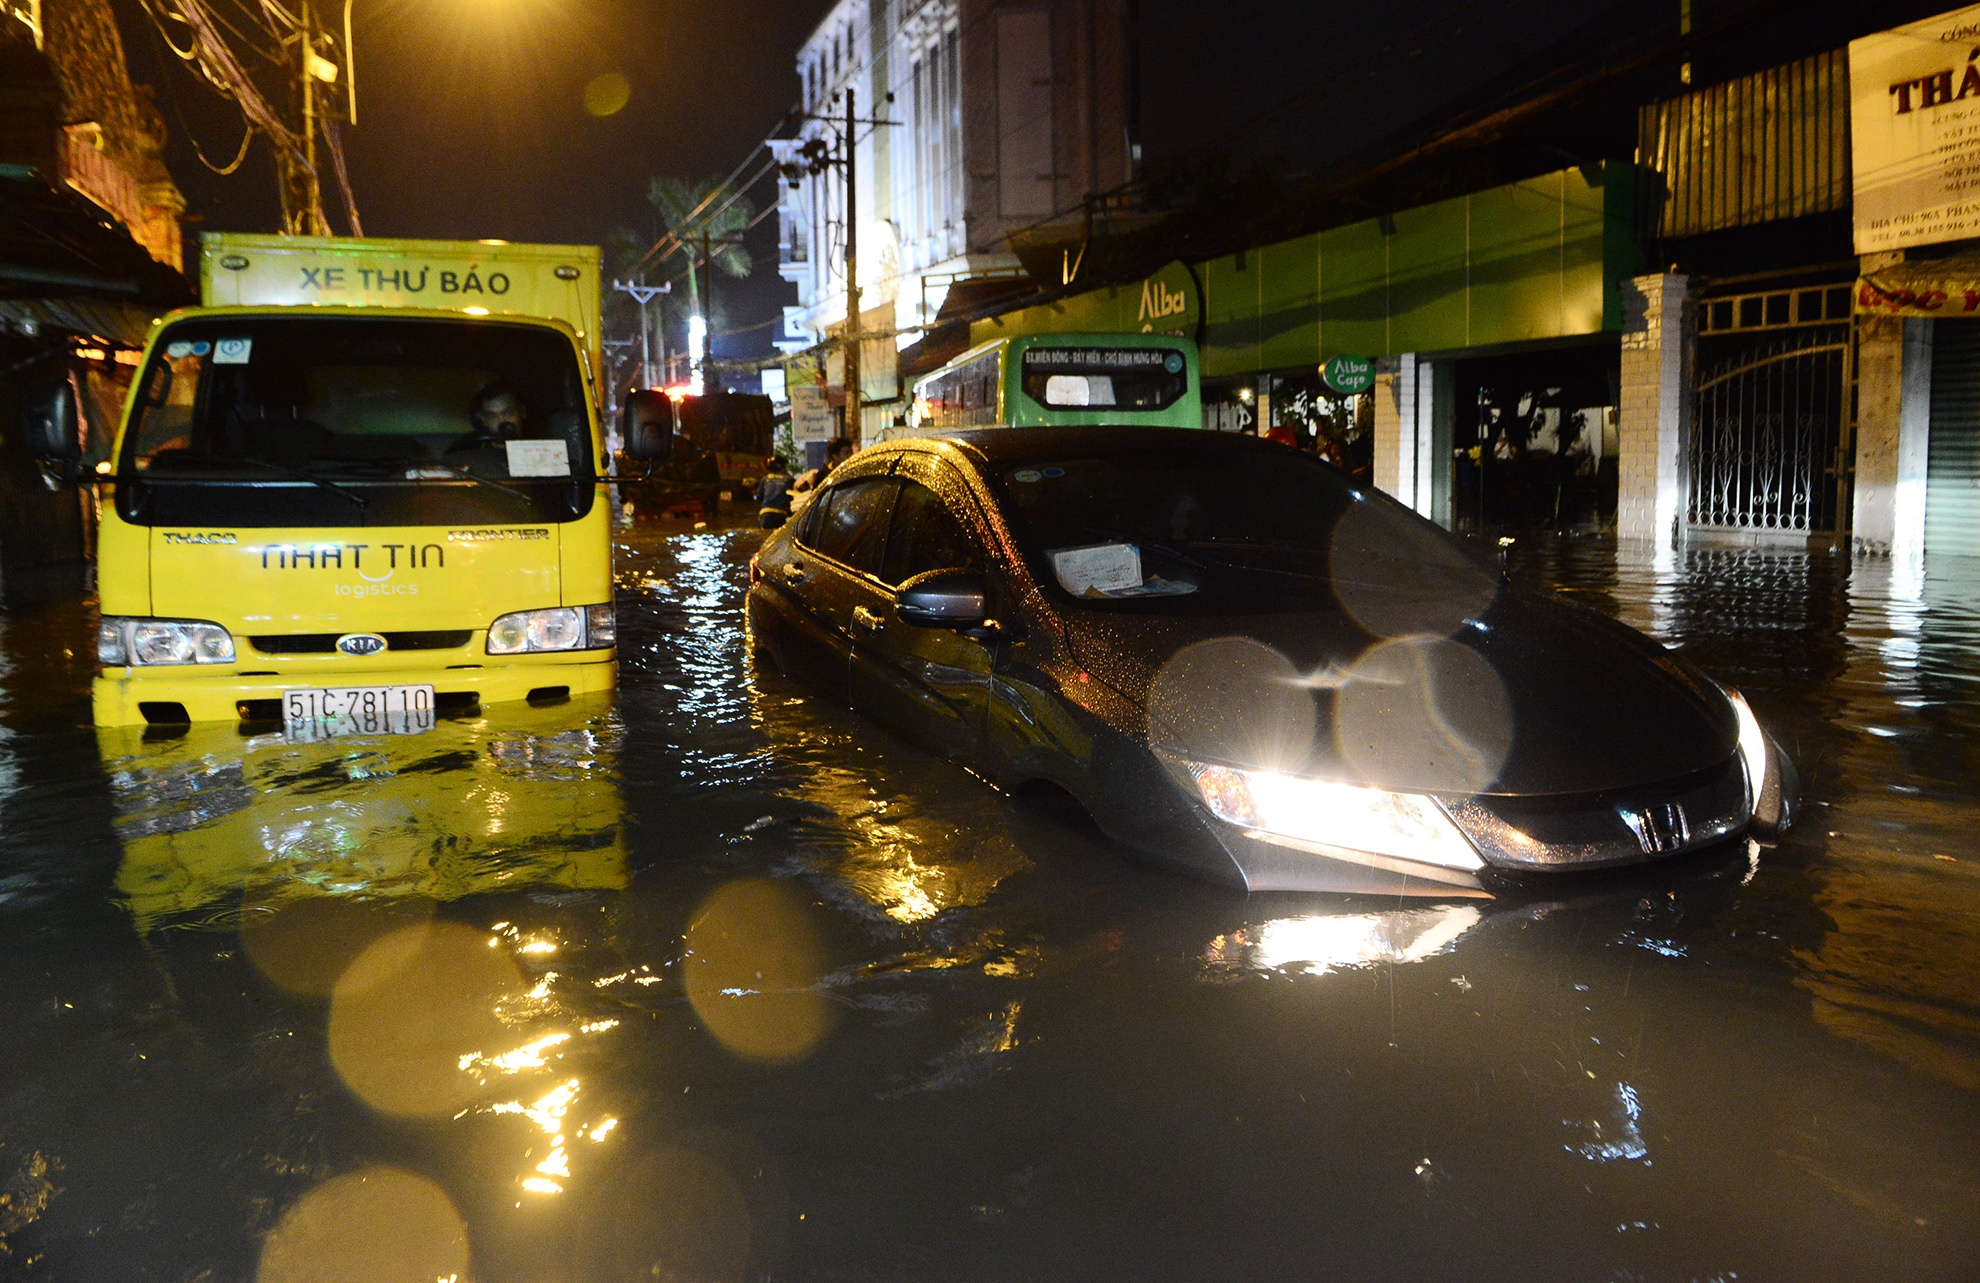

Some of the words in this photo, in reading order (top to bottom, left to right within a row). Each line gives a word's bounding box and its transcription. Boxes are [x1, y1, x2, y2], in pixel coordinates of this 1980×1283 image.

[300, 266, 345, 291] XE
[357, 264, 430, 293] THƯ
[440, 263, 510, 295] BÁO
[1138, 279, 1185, 321] Alba
[1334, 359, 1368, 374] Alba
[163, 533, 237, 545] THACO
[448, 528, 549, 542] FRONTIER
[334, 582, 418, 599] logistics
[346, 638, 377, 651] KIA
